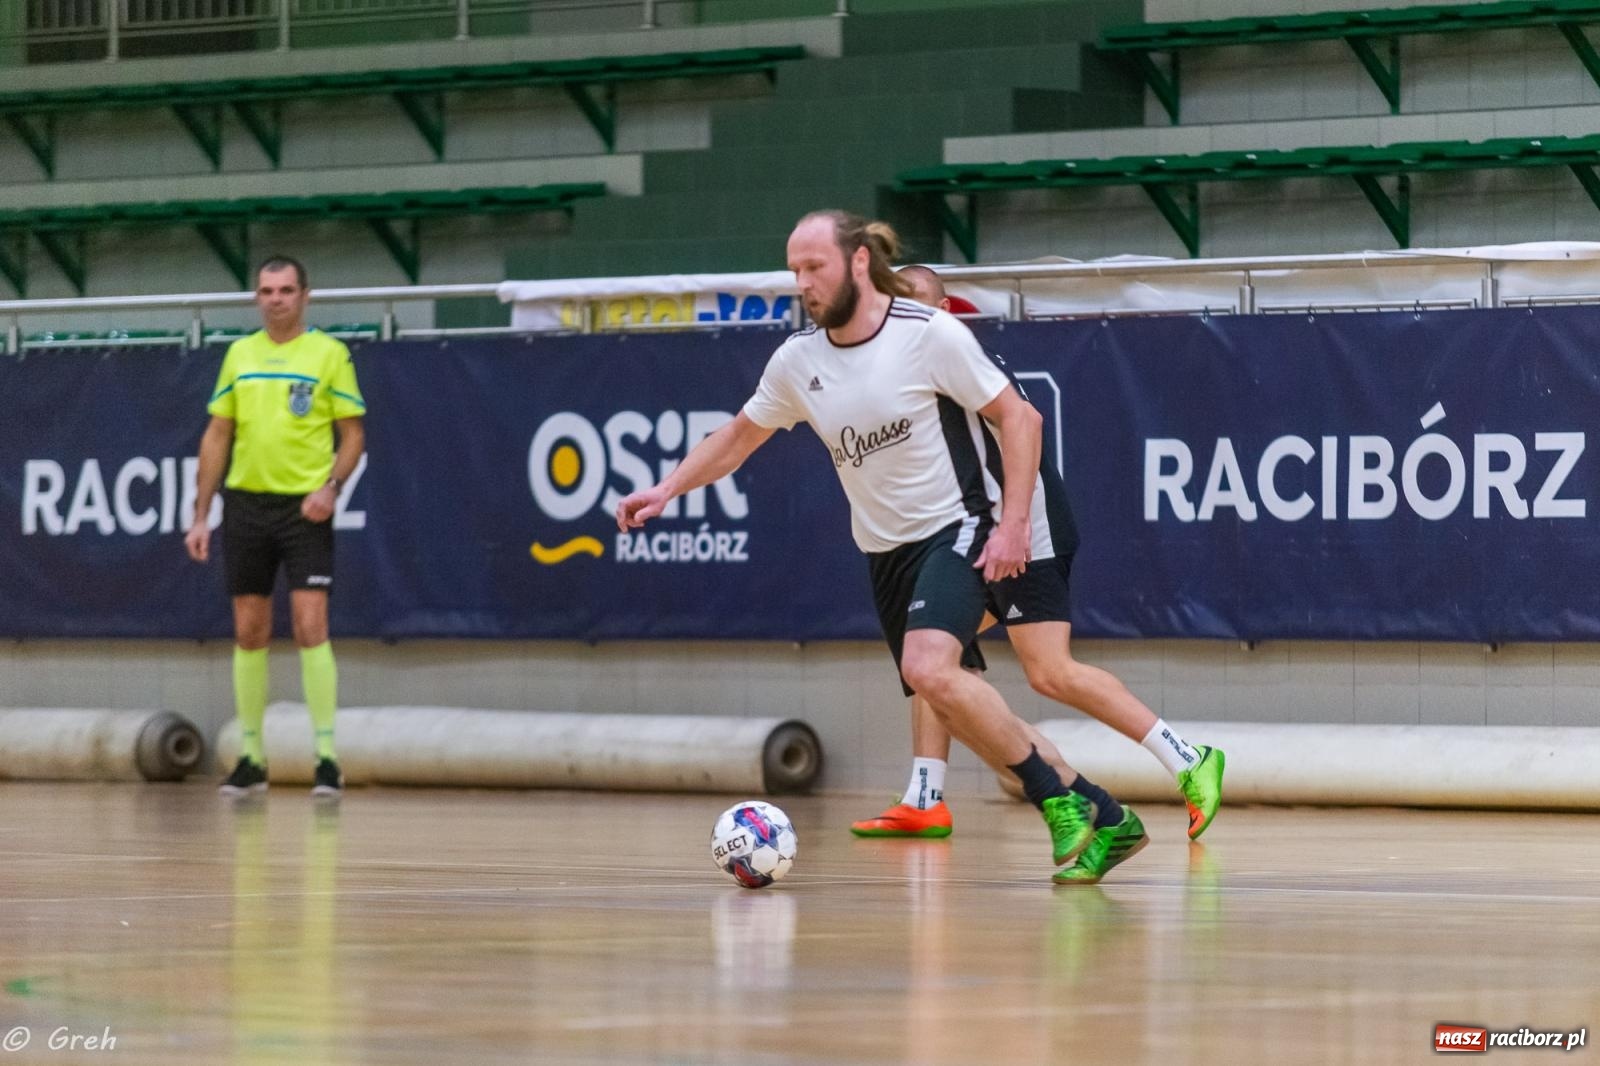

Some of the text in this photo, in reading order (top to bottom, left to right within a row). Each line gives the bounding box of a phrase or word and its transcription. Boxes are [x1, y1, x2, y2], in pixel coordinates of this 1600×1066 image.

[841, 418, 913, 468] Grasso
[1143, 401, 1586, 522] RACIBÓRZ
[616, 523, 749, 562] RACIBÓRZ
[713, 835, 748, 860] SELECT
